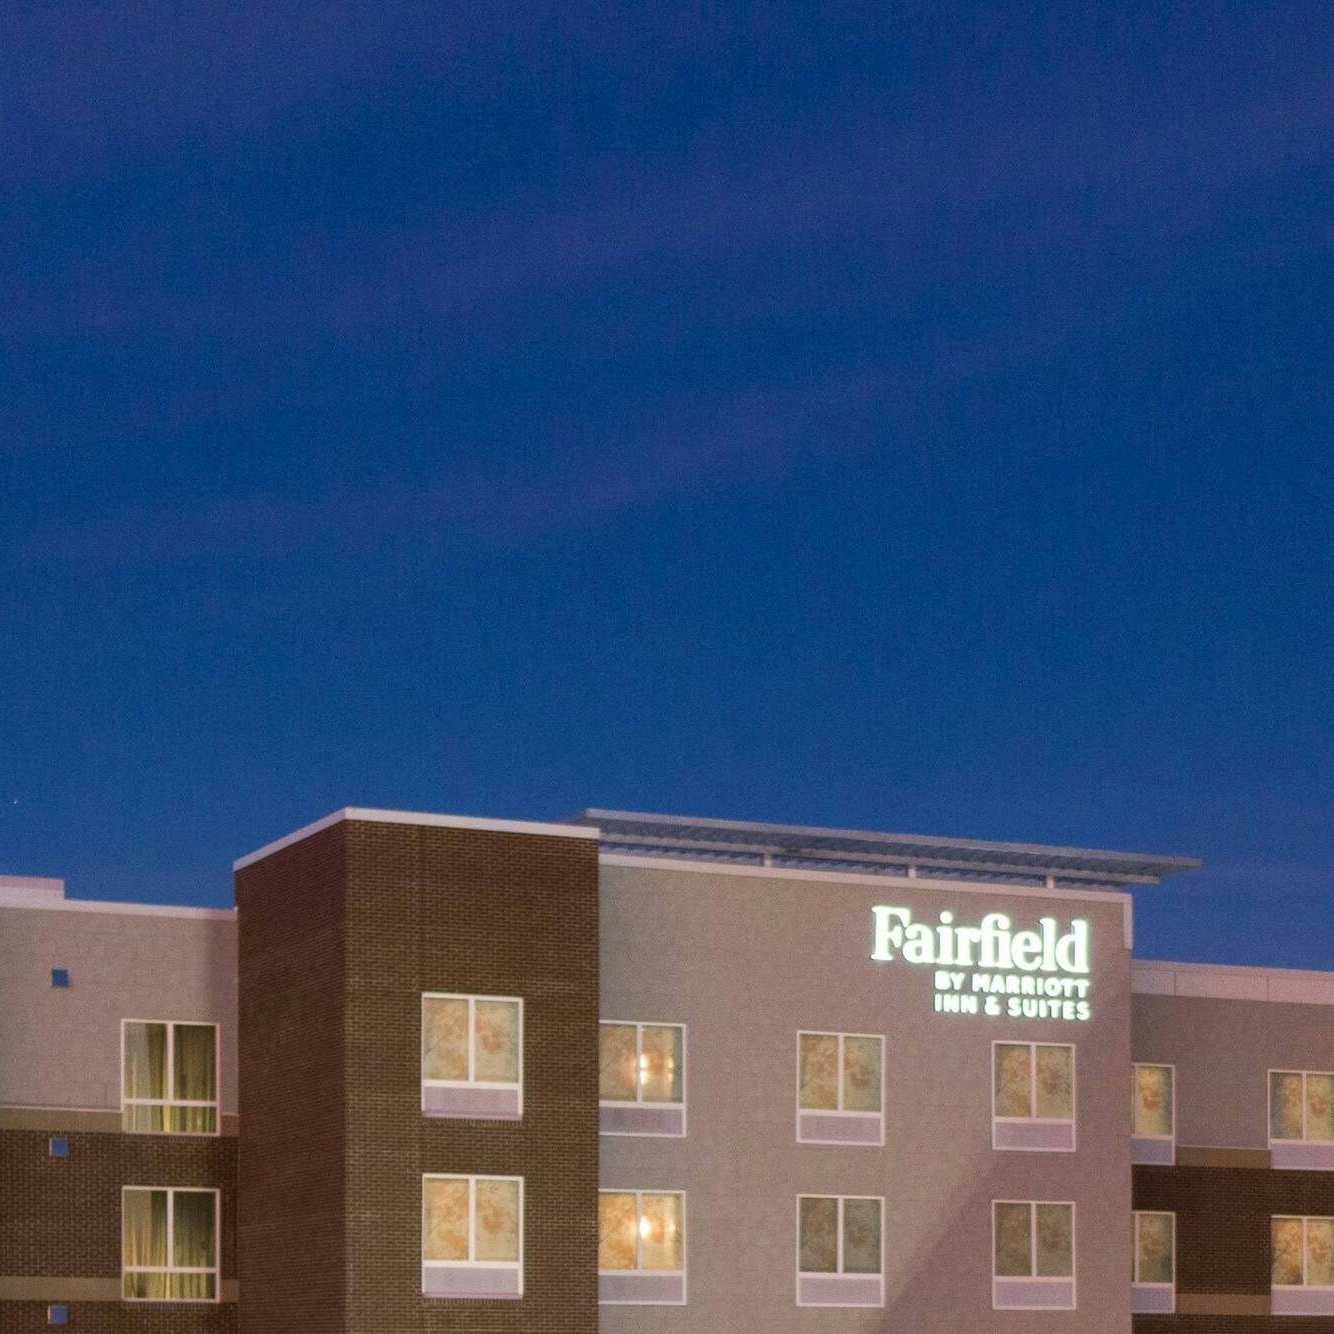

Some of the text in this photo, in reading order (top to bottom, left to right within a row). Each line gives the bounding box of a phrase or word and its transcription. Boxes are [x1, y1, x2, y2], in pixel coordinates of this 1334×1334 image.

[871, 905, 1090, 973] Fairfield
[934, 971, 1091, 998] BY MARRIOTT
[934, 993, 1091, 1020] INN & SUITES
